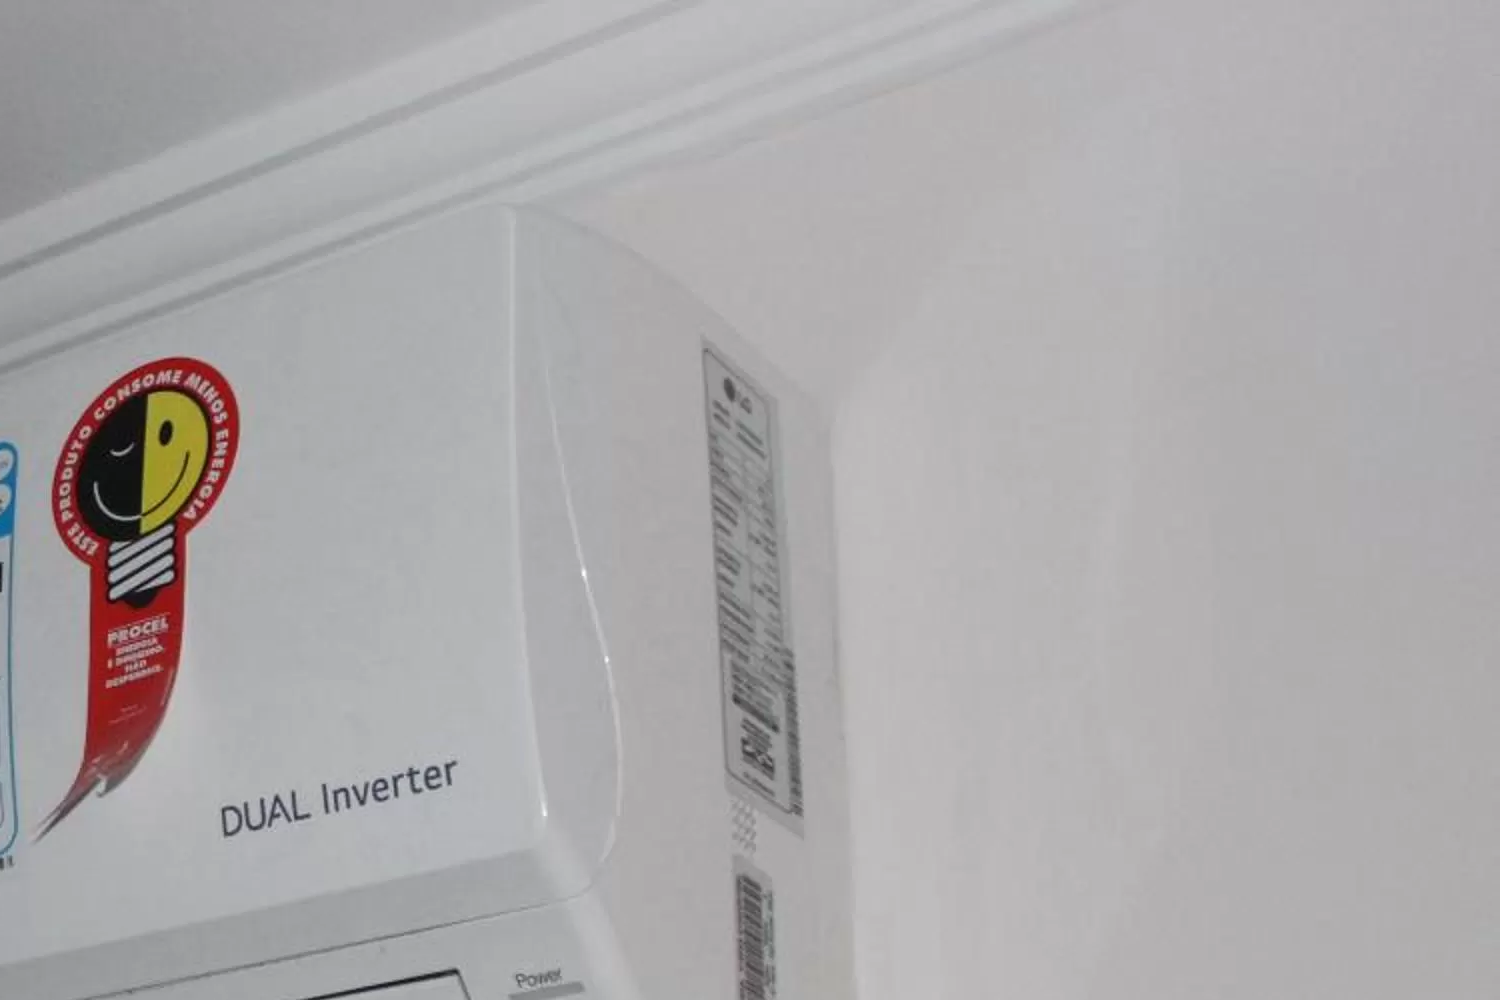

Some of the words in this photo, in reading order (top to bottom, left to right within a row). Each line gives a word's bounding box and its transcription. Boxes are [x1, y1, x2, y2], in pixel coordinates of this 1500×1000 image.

[93, 369, 182, 421] CONSOME
[182, 371, 228, 424] MENOS
[59, 424, 92, 523] PRODUTO
[184, 428, 229, 520] ENERGIA
[67, 521, 100, 556] ESTE
[107, 614, 169, 648] PROCEL
[220, 789, 312, 839] DUAL
[321, 760, 459, 815] Inverter
[515, 968, 562, 989] Power
